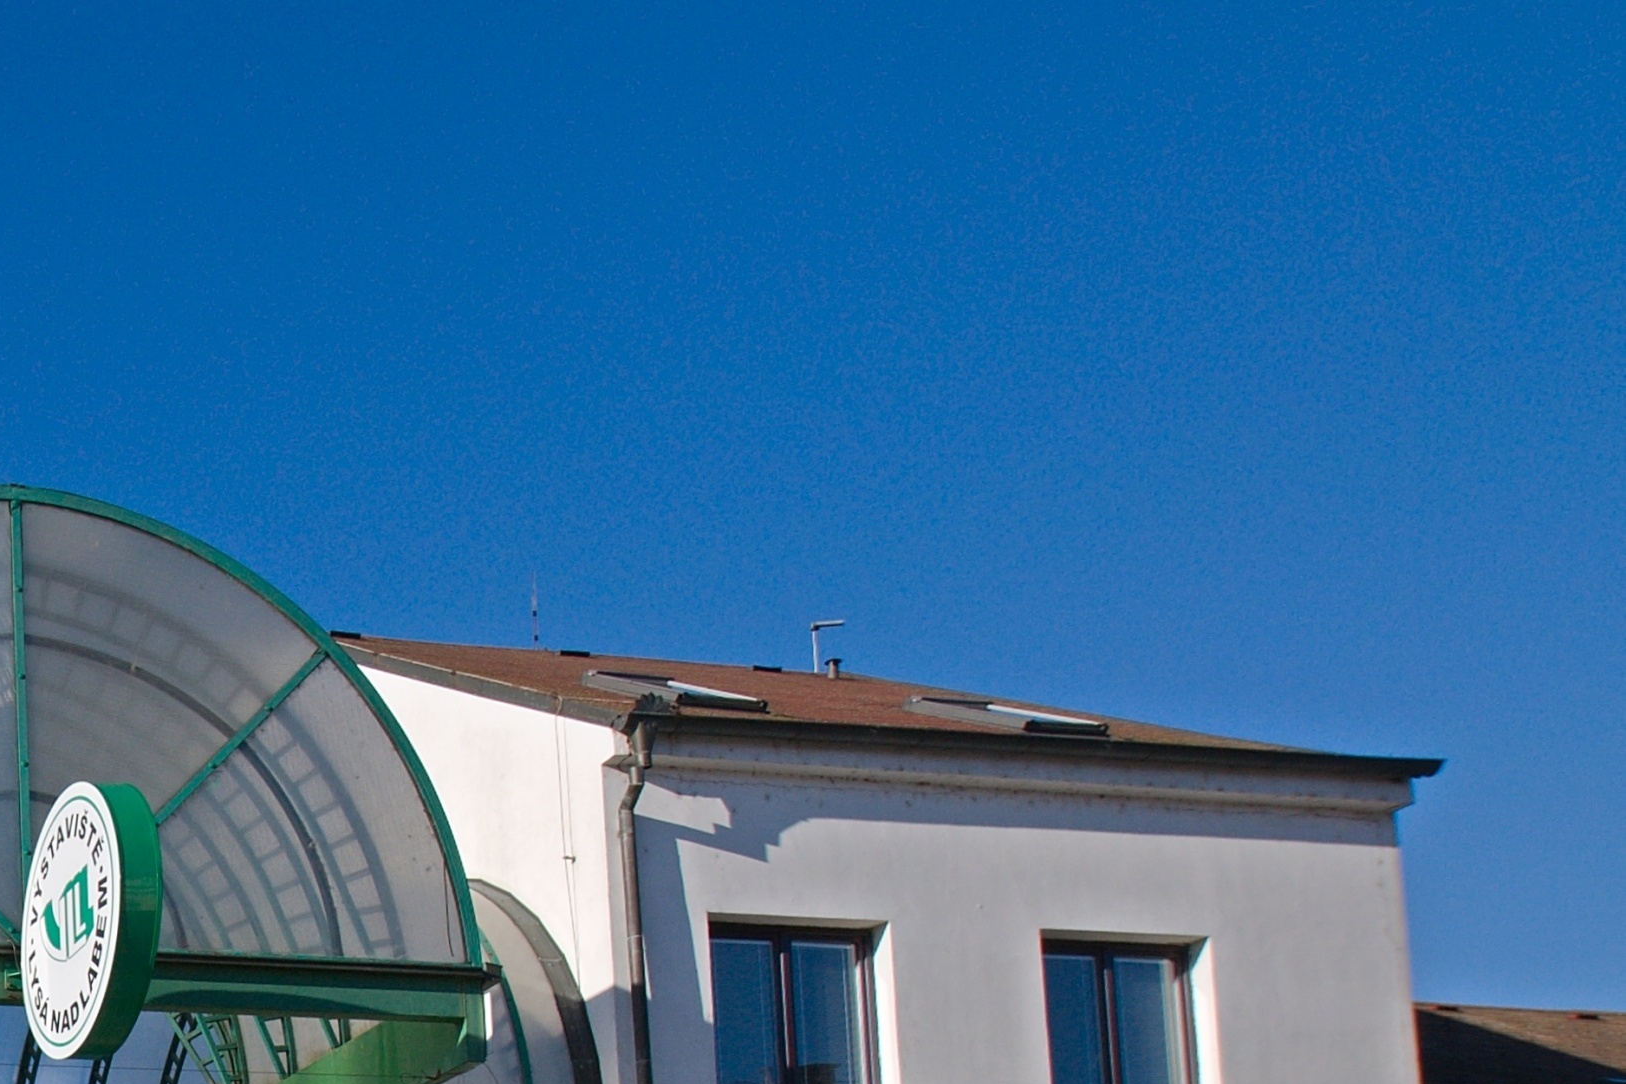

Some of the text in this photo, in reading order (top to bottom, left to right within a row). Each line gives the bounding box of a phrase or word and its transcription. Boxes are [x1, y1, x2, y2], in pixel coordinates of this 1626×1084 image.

[30, 809, 105, 928] VÝSTAVIŠTĚ
[27, 876, 108, 1034] LYSÁ NAD LABEM
